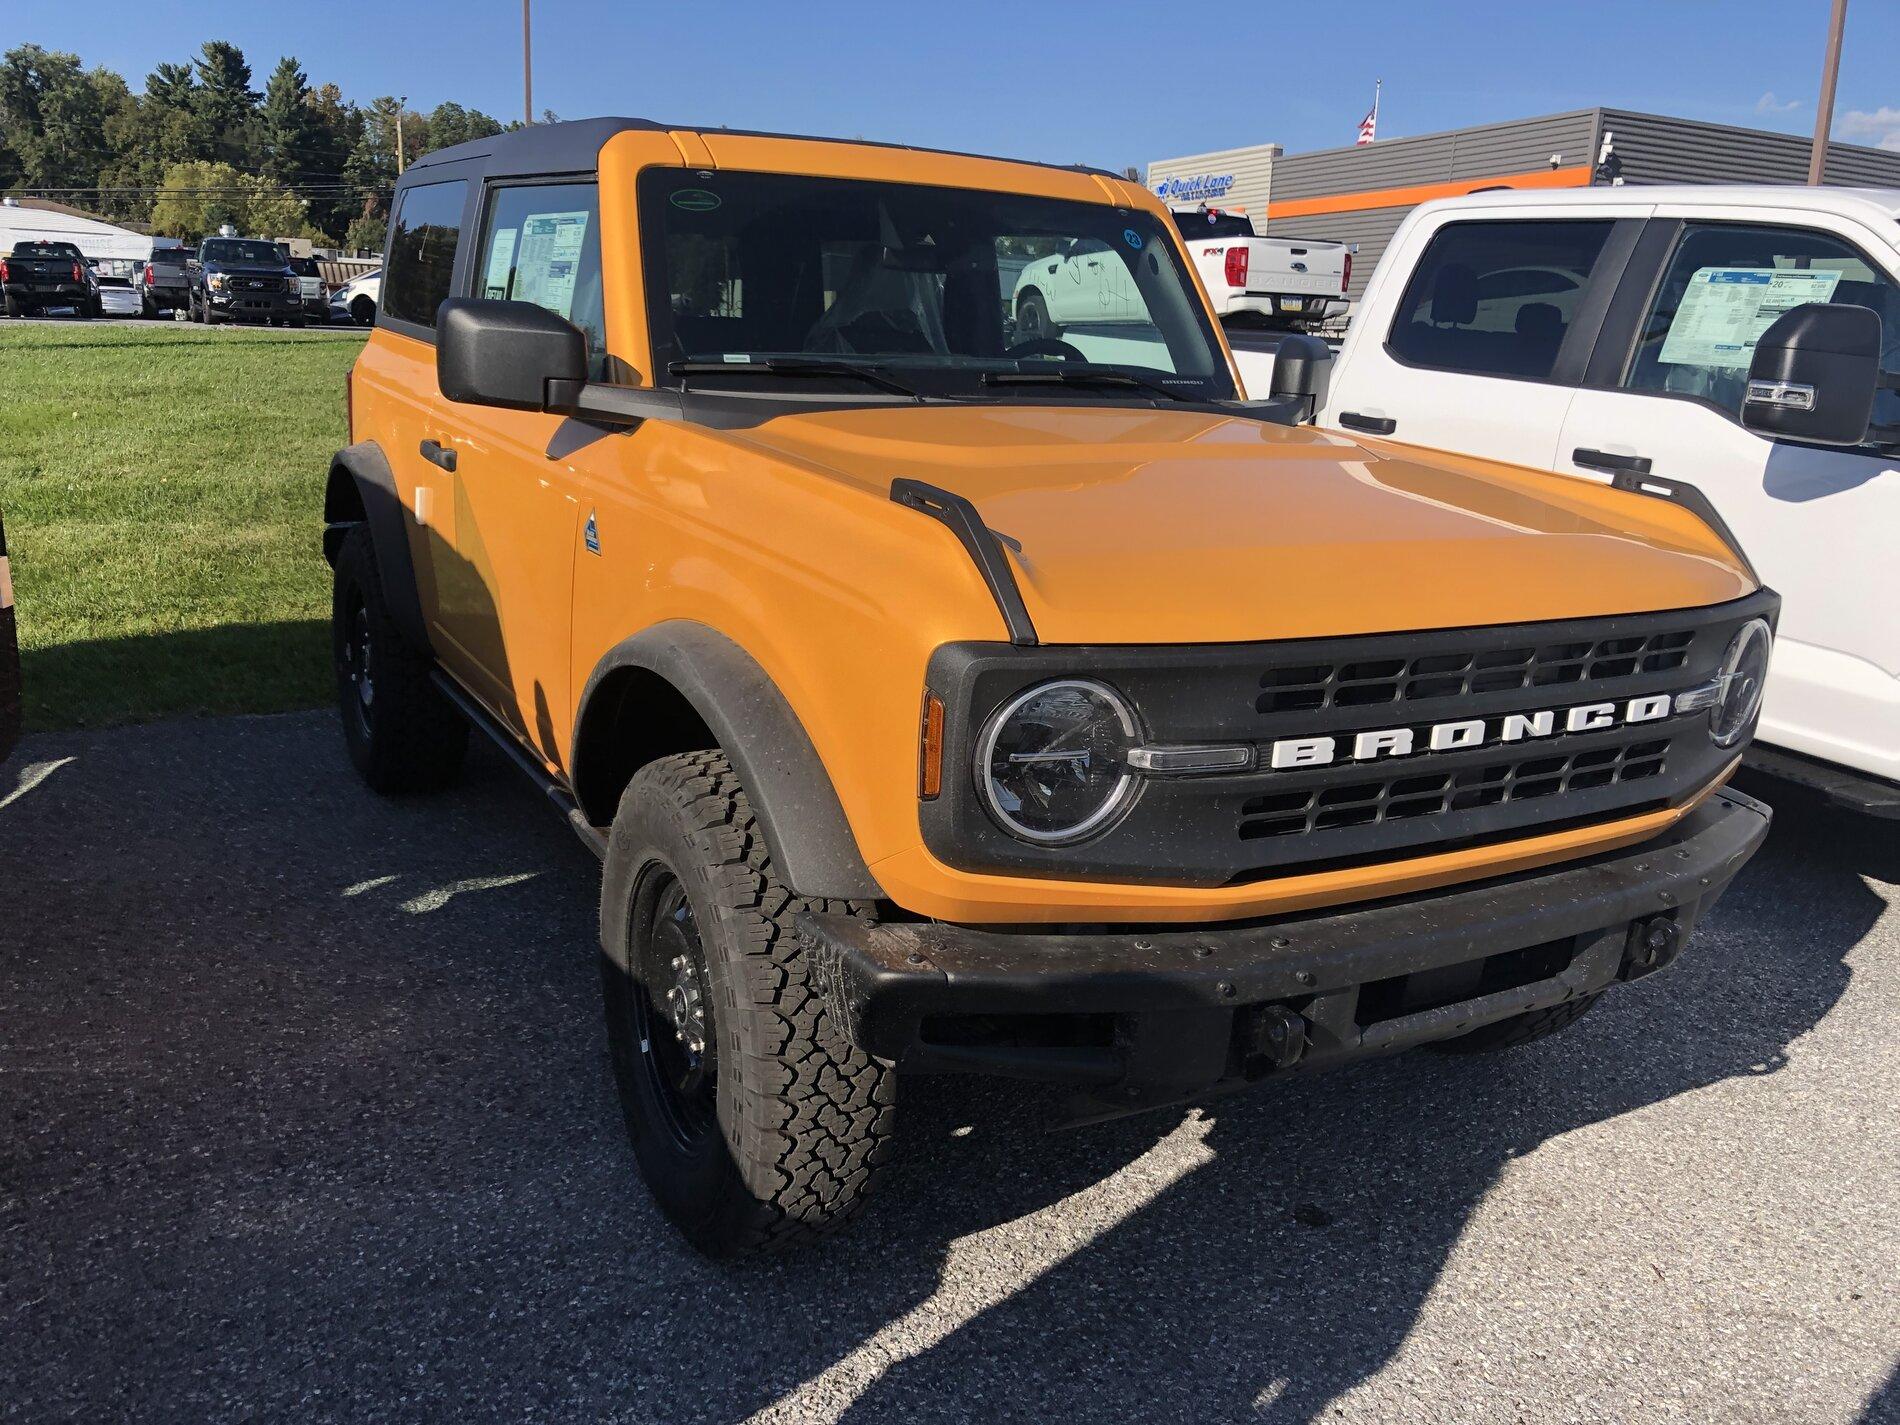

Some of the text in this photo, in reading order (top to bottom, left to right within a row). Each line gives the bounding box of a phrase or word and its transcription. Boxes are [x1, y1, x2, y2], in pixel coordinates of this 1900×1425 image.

[1171, 174, 1233, 194] Quick Lane
[1203, 247, 1224, 256] FX4
[1271, 695, 1671, 769] BRONCO
